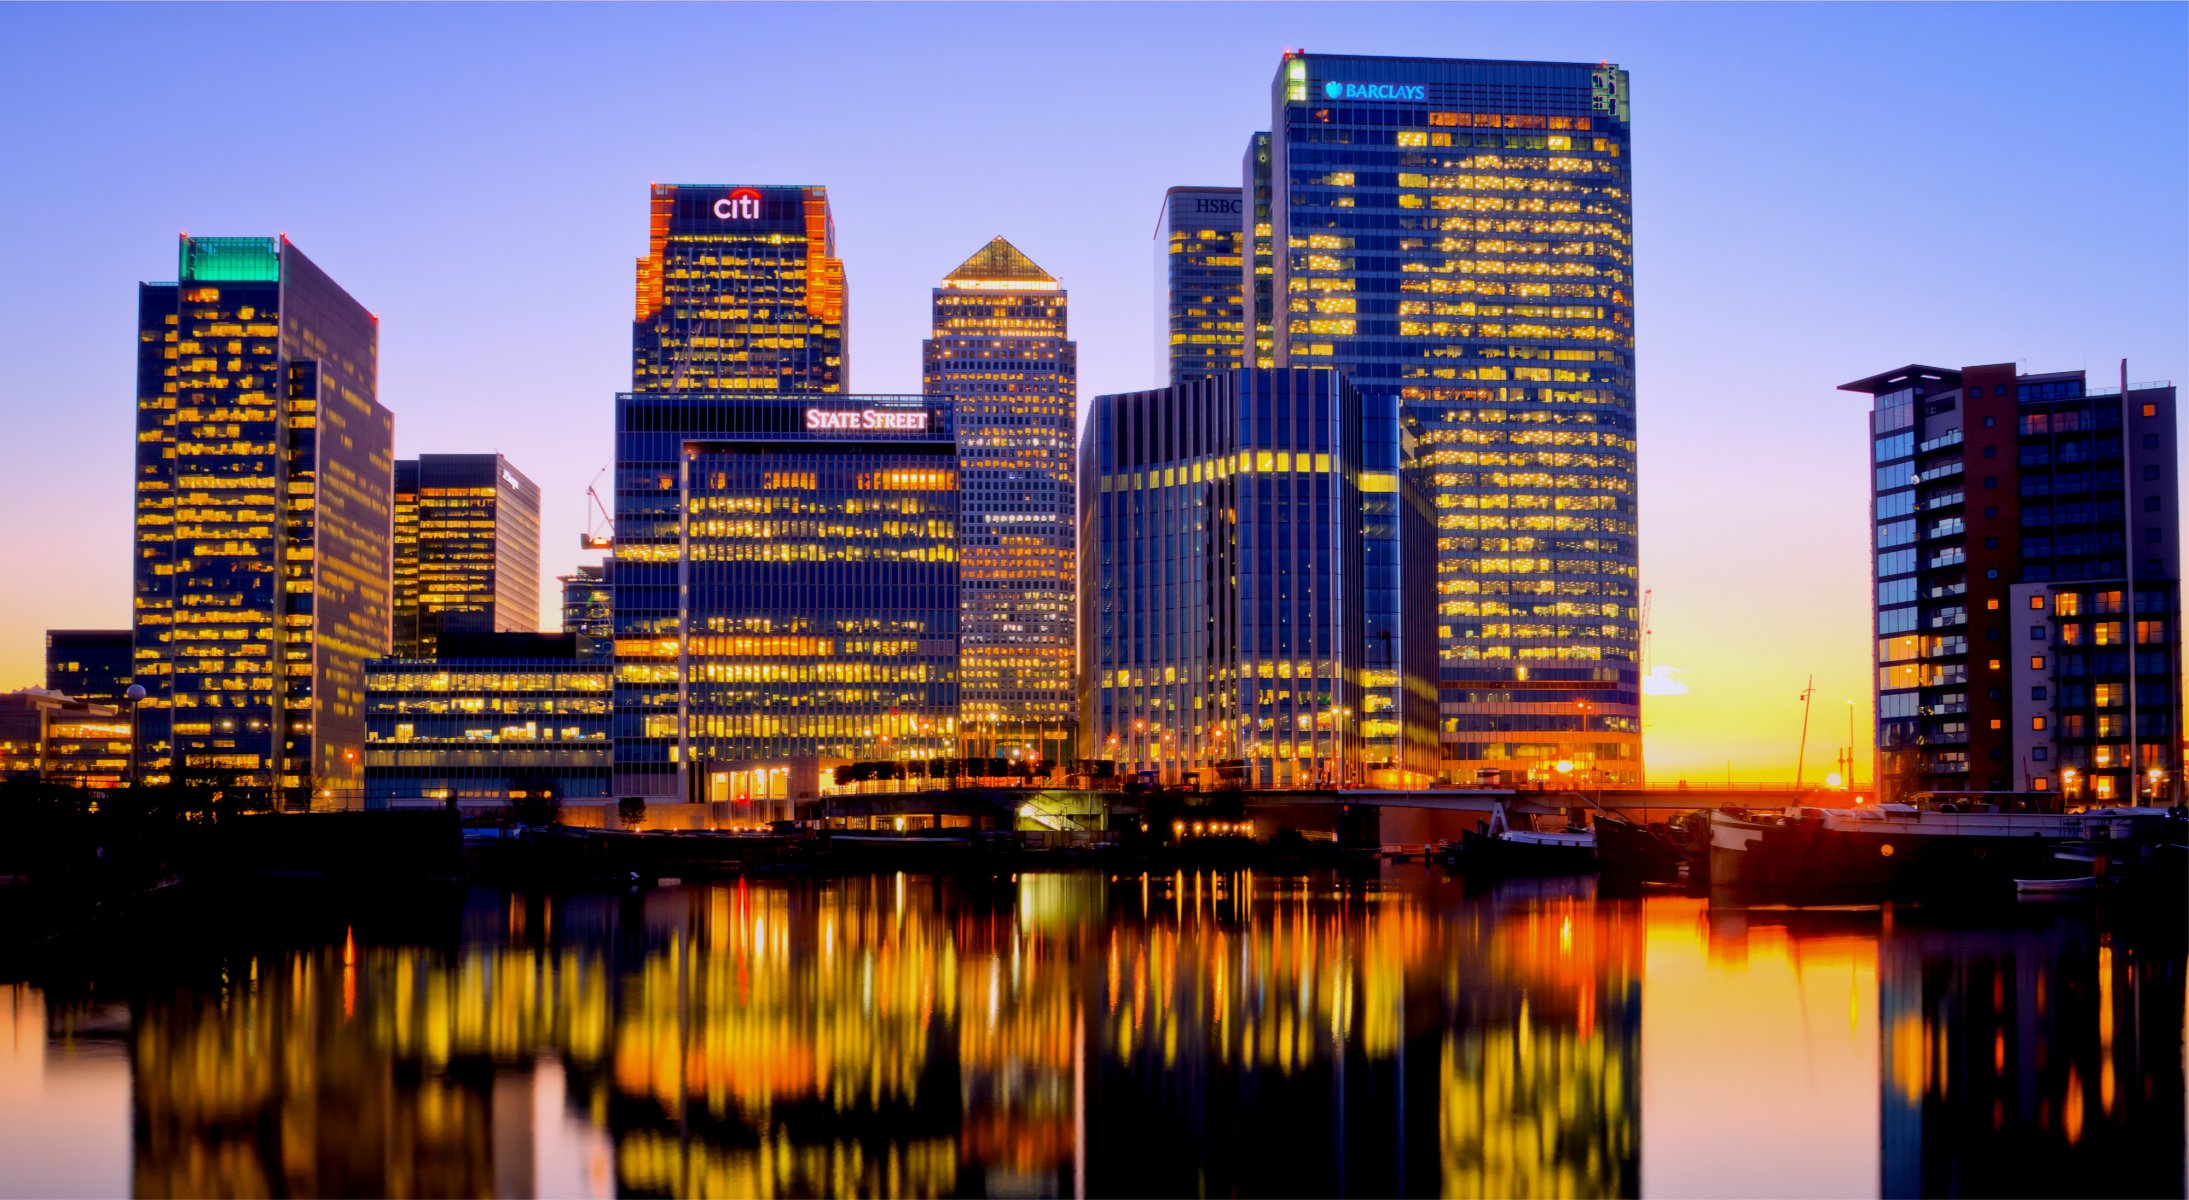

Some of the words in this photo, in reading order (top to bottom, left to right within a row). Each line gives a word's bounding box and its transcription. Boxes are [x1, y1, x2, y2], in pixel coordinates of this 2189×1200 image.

[1345, 84, 1425, 100] BARCLAYS
[714, 195, 760, 219] citi
[1195, 199, 1242, 213] HSBC
[806, 409, 860, 429] STATE
[863, 410, 928, 429] STREET
